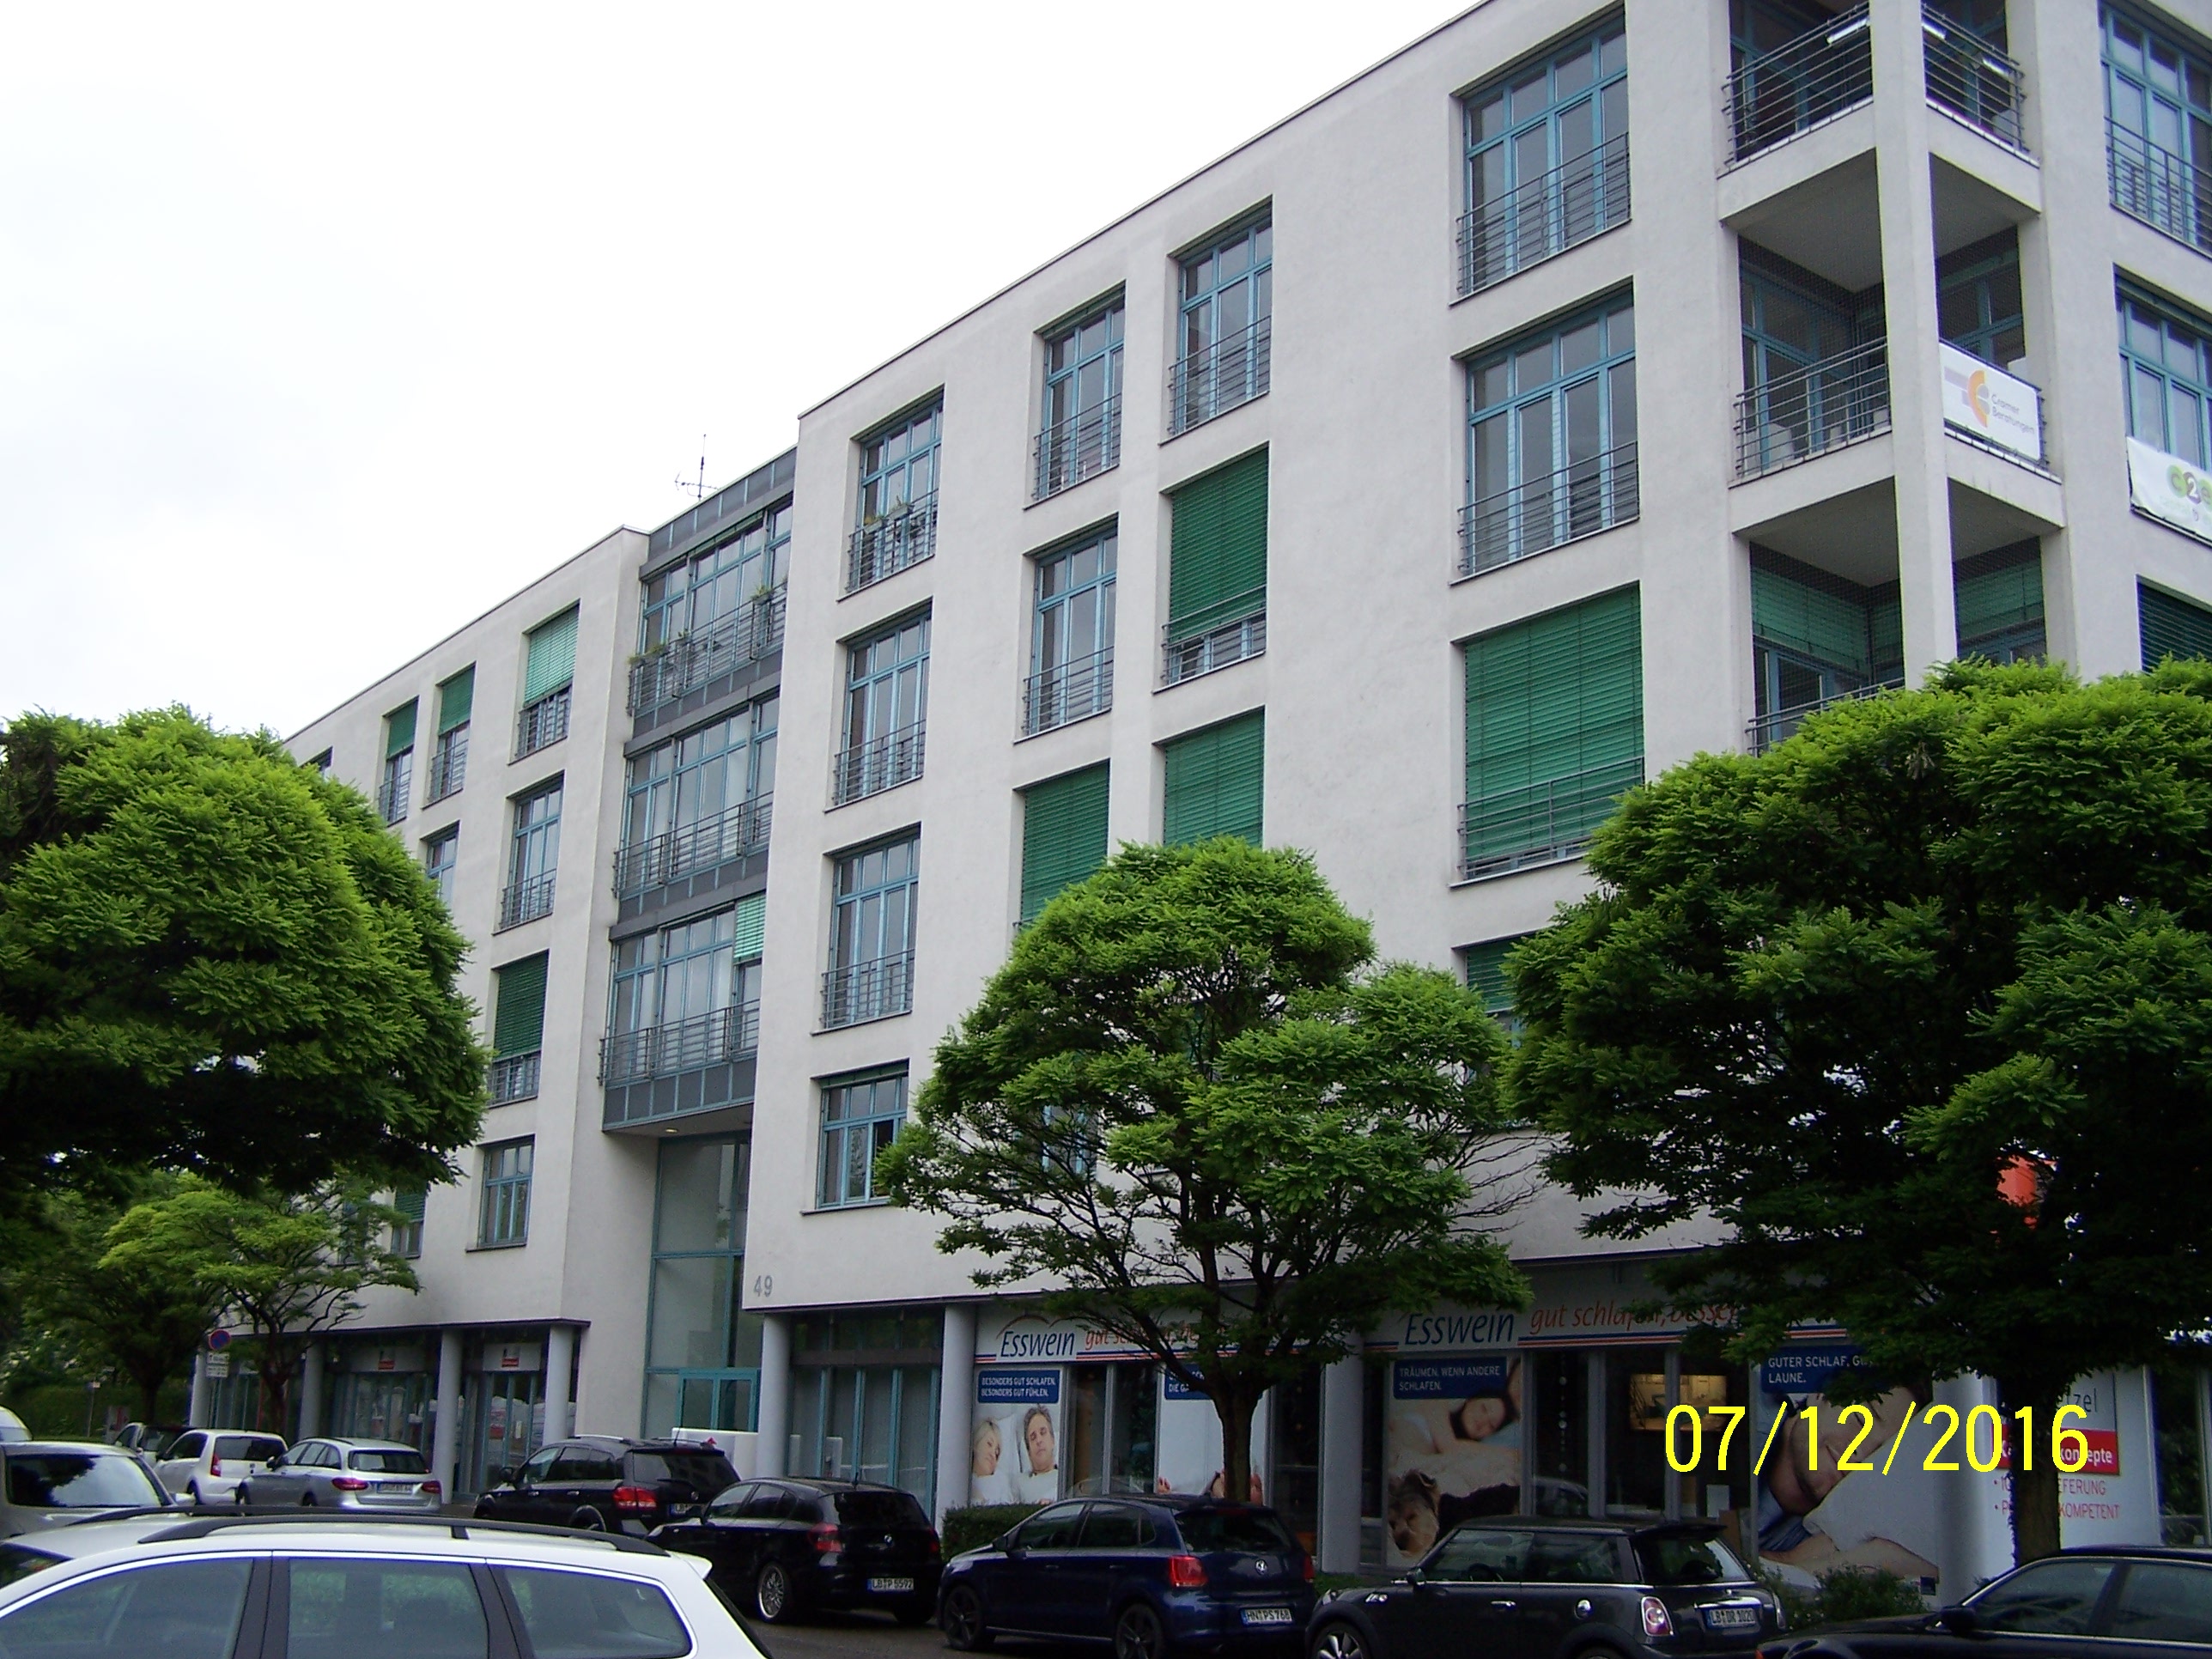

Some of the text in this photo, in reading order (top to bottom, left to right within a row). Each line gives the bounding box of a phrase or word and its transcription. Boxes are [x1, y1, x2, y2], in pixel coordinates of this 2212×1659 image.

[753, 1275, 773, 1297] 49
[1528, 1304, 1567, 1334] gut
[1405, 1313, 1514, 1345] Esswein
[1000, 1331, 1075, 1357] Esswein
[1768, 1356, 1802, 1368] GUTER
[1805, 1355, 1850, 1368] SCHLAF.
[1441, 1366, 1465, 1376] WENN
[1467, 1365, 1500, 1376] ANDERE
[1768, 1372, 1807, 1384] LAUNE.
[981, 1376, 1013, 1386] BESONDERS
[1013, 1376, 1024, 1386] GUT
[981, 1388, 1012, 1397] BESONDERS
[1013, 1388, 1024, 1397] GUT
[2060, 1447, 2113, 1468] konepte
